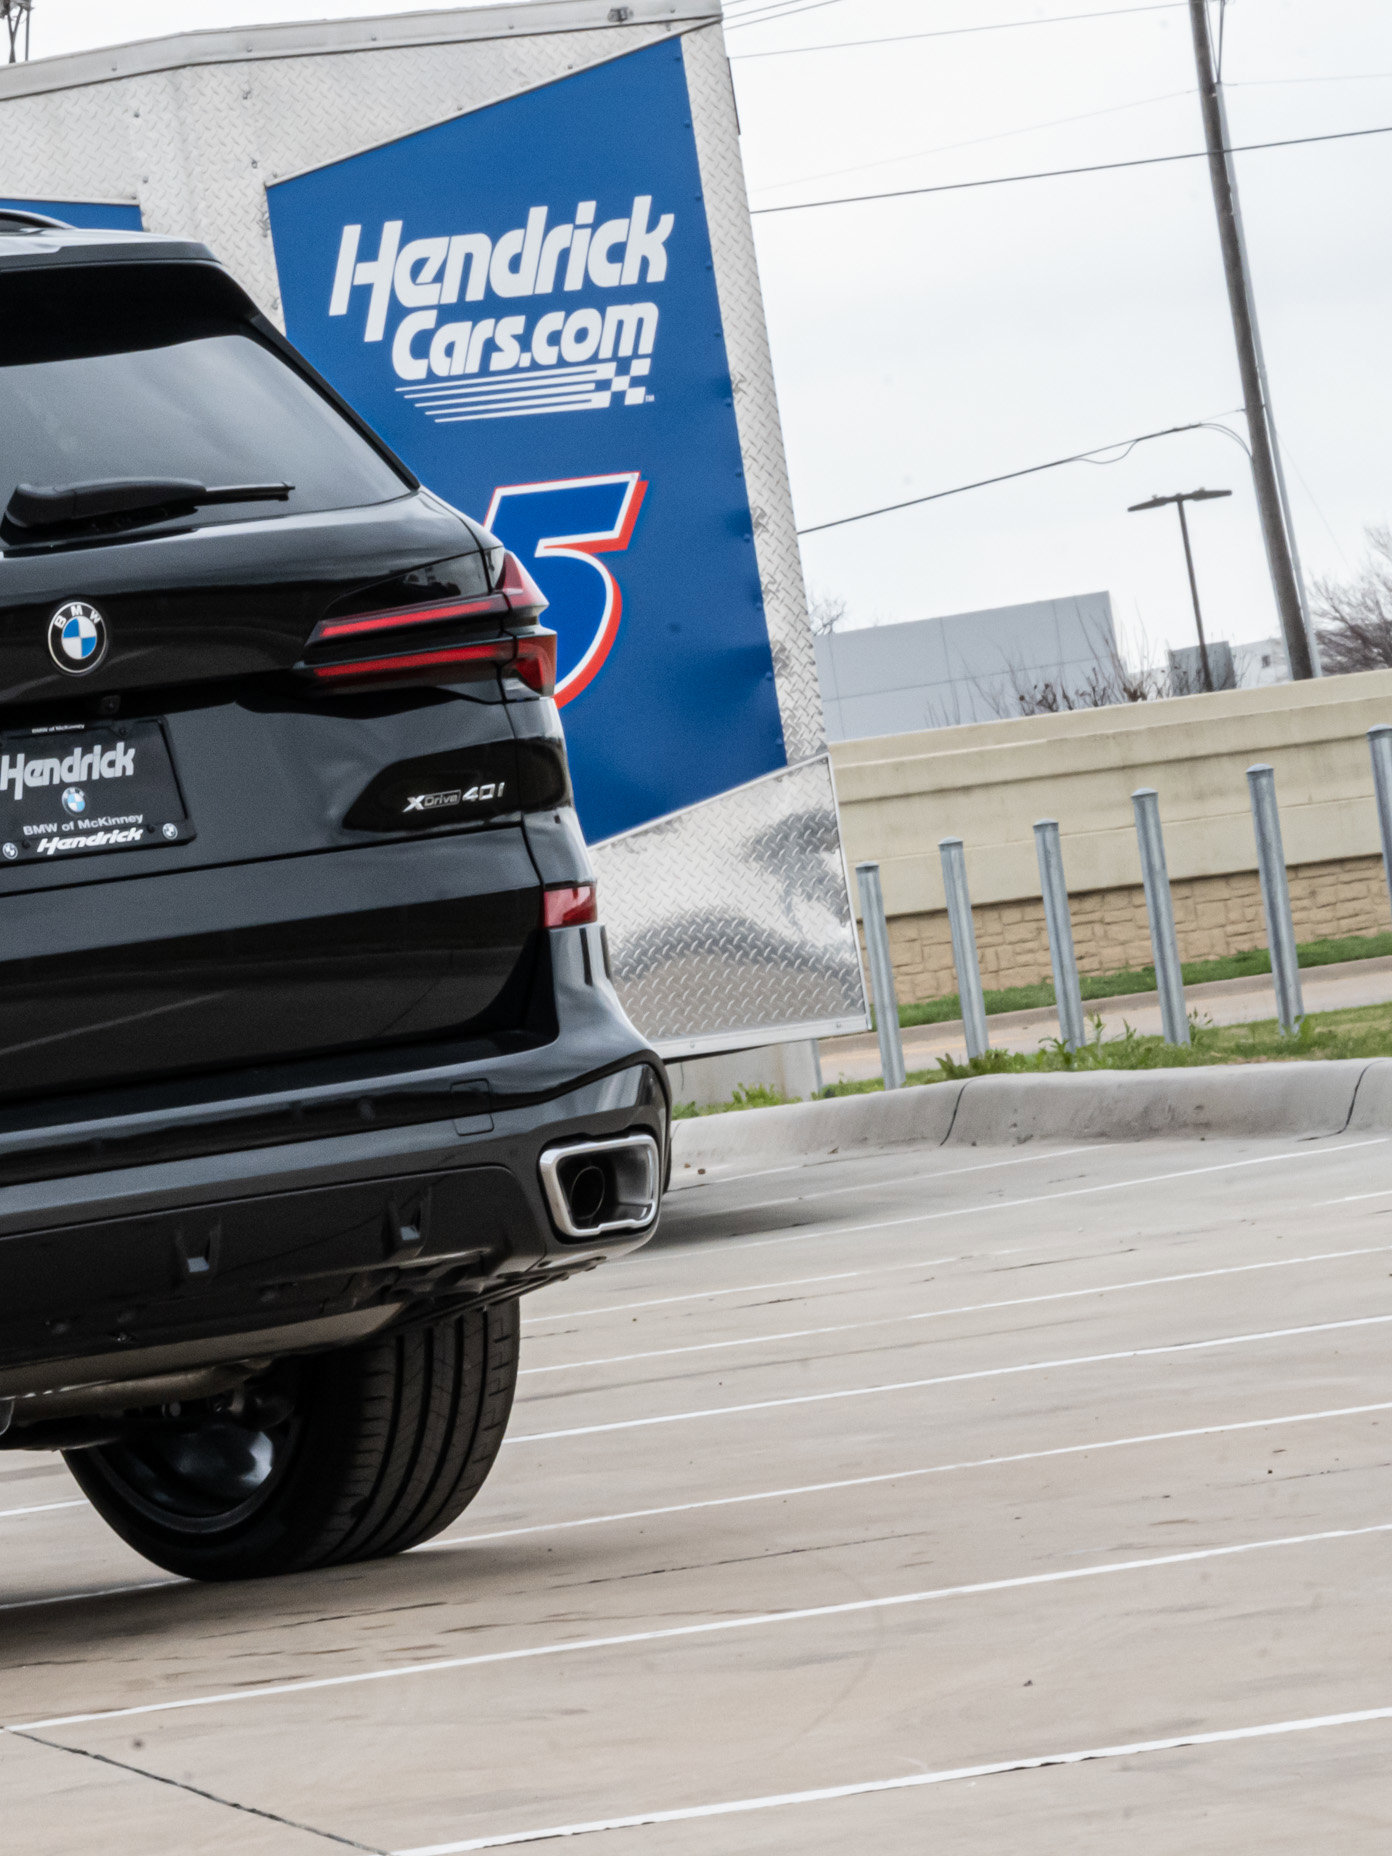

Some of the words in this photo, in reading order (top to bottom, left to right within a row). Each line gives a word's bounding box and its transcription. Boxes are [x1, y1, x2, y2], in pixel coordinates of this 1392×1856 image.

[328, 194, 674, 342] Hendrick
[391, 301, 659, 380] Cars.com
[54, 604, 101, 629] BMW
[483, 471, 649, 710] 5
[0, 741, 136, 801] Hendrick
[23, 823, 58, 836] BMW
[61, 820, 75, 832] of
[77, 814, 144, 830] McKinney
[36, 827, 144, 856] Hendrick
